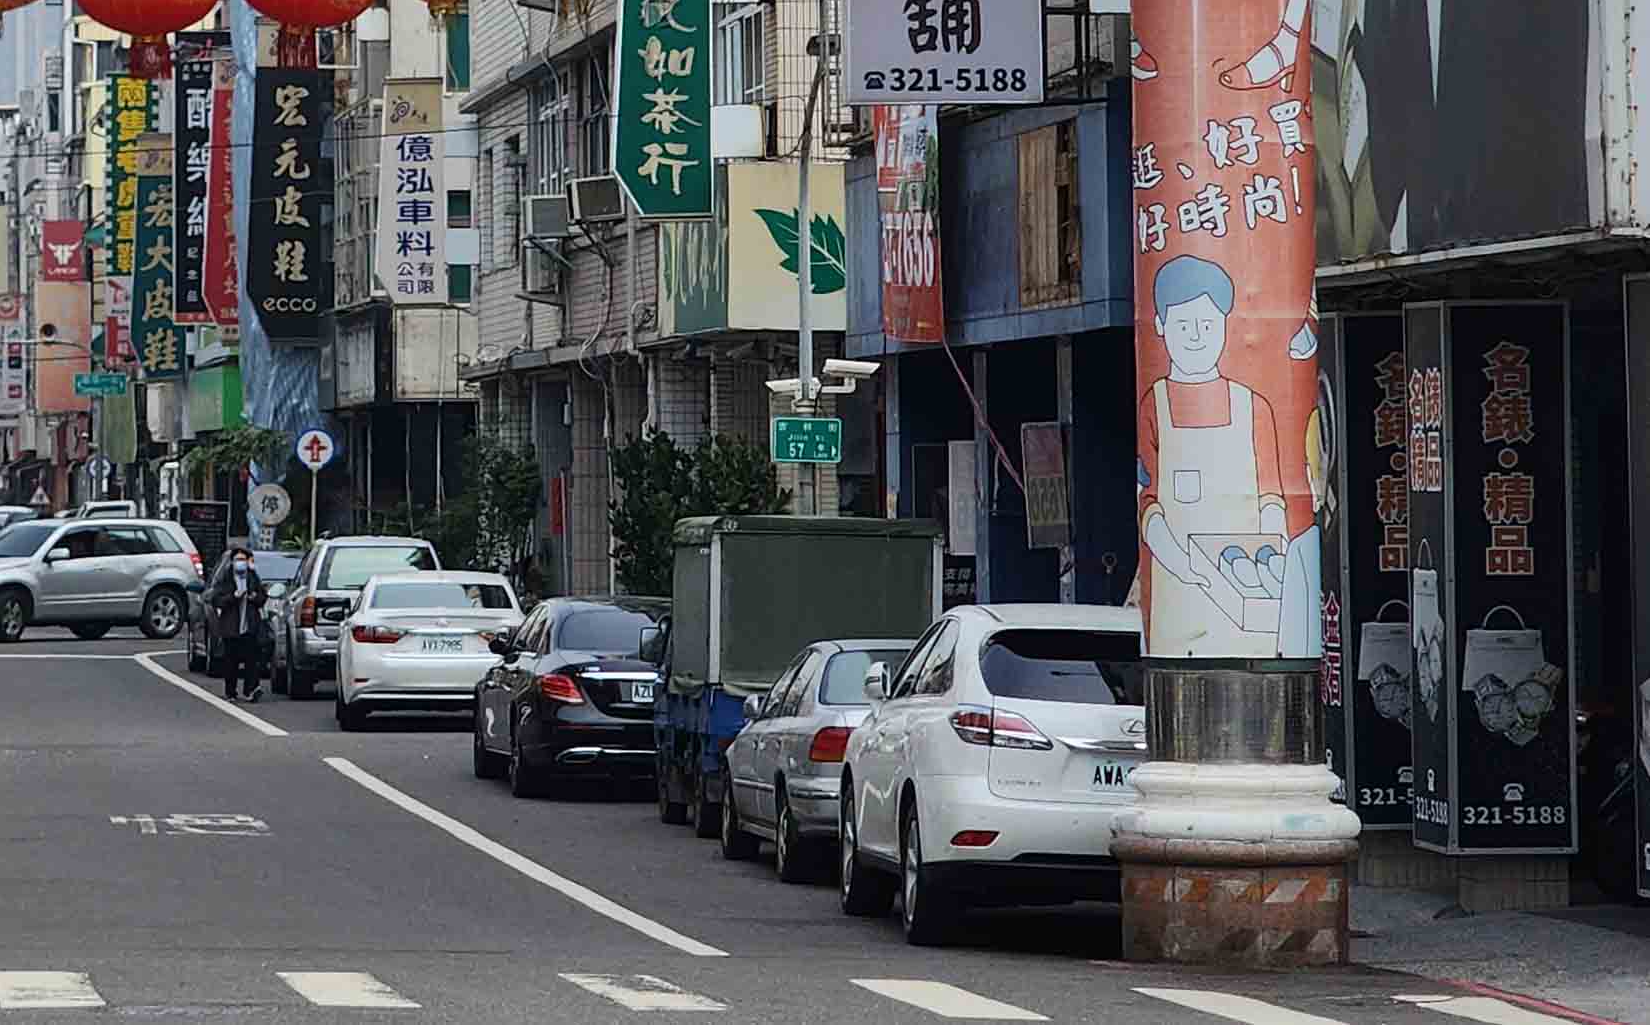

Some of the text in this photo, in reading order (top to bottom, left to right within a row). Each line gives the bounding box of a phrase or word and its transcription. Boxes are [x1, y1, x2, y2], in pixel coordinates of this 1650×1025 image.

[890, 68, 1027, 92] 321-5188
[272, 84, 311, 283] 宏元皮鞋
[396, 135, 436, 258] 億泓車料
[140, 183, 179, 372] 宏大皮鞋
[262, 296, 318, 313] ecco
[789, 442, 805, 458] 57
[1462, 806, 1566, 825] 321-5188
